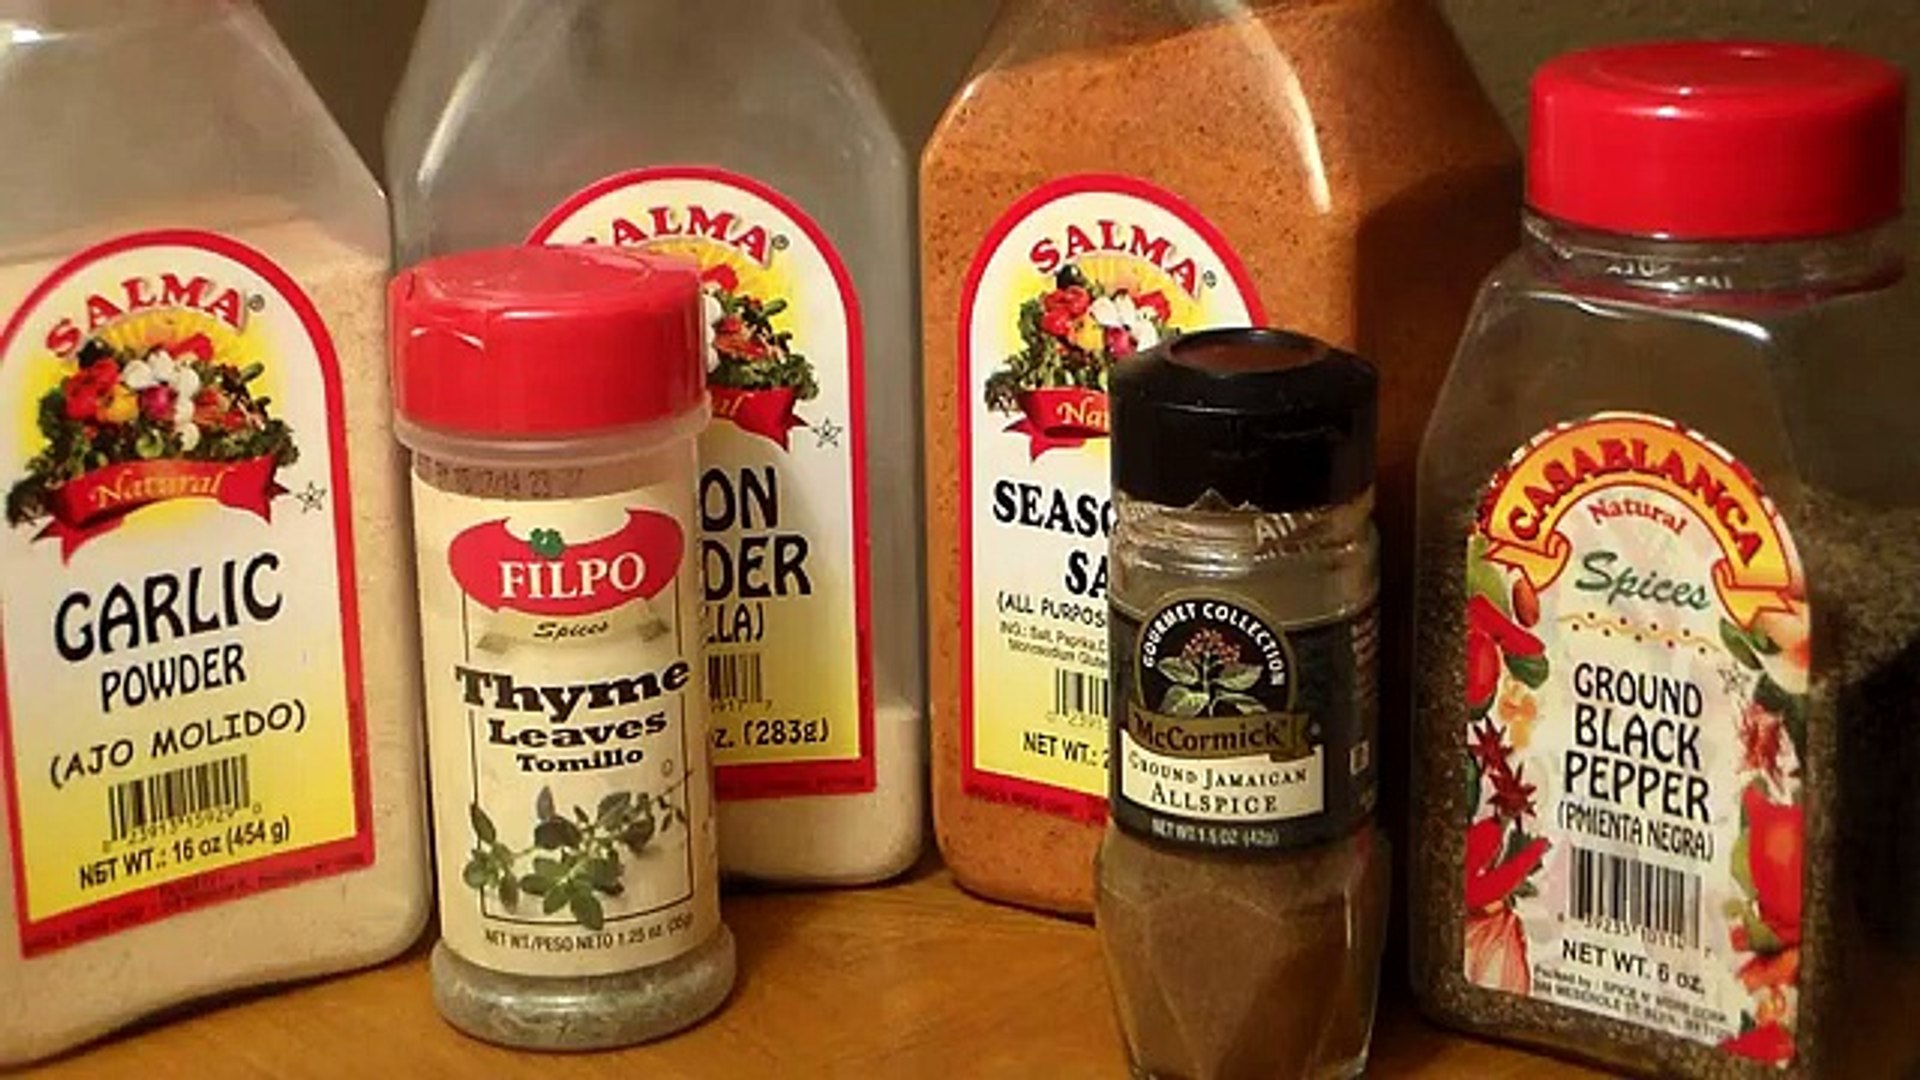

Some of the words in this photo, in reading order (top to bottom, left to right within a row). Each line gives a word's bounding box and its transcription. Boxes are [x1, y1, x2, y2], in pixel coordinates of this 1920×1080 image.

[595, 205, 767, 264] ALMA
[1030, 219, 1201, 300] SALMA
[46, 273, 244, 358] SALMA
[91, 466, 234, 507] Natural
[1509, 437, 1763, 567] CASABLANCA
[1587, 497, 1688, 536] Natural
[499, 551, 647, 599] FILPO
[998, 591, 1034, 614] (ALL
[1575, 552, 1711, 611] Spices
[54, 553, 283, 661] GARLIC
[533, 620, 609, 641] Spices
[1143, 602, 1197, 668] GOURMET
[1203, 602, 1286, 686] COLLECTION
[101, 644, 247, 713] POWDER
[455, 661, 690, 724] Thyme
[1574, 662, 1702, 719] GROUND
[50, 739, 134, 788] (AJO
[151, 699, 306, 759] MOLIDO)
[488, 711, 668, 749] Leaves
[743, 717, 829, 746] (283g)
[1023, 731, 1058, 758] NET
[1133, 712, 1281, 752] McCormick
[1575, 702, 1700, 771] BLACK
[517, 747, 644, 773] Tomillo
[1128, 750, 1198, 784] GROUND
[1204, 767, 1307, 791] JAMAICAN
[1565, 750, 1710, 824] PEPPER
[1151, 781, 1278, 814] ALLSPICE
[173, 838, 195, 864] 16
[198, 836, 222, 856] oz
[227, 820, 265, 856] (454
[269, 813, 291, 845] g)
[1557, 800, 1643, 846] (PMIENTA
[1647, 816, 1714, 863] NEGRA)
[1562, 939, 1607, 967] NET
[1612, 950, 1651, 979] WT.
[1657, 962, 1669, 982] 6
[1676, 971, 1706, 995] oz.
